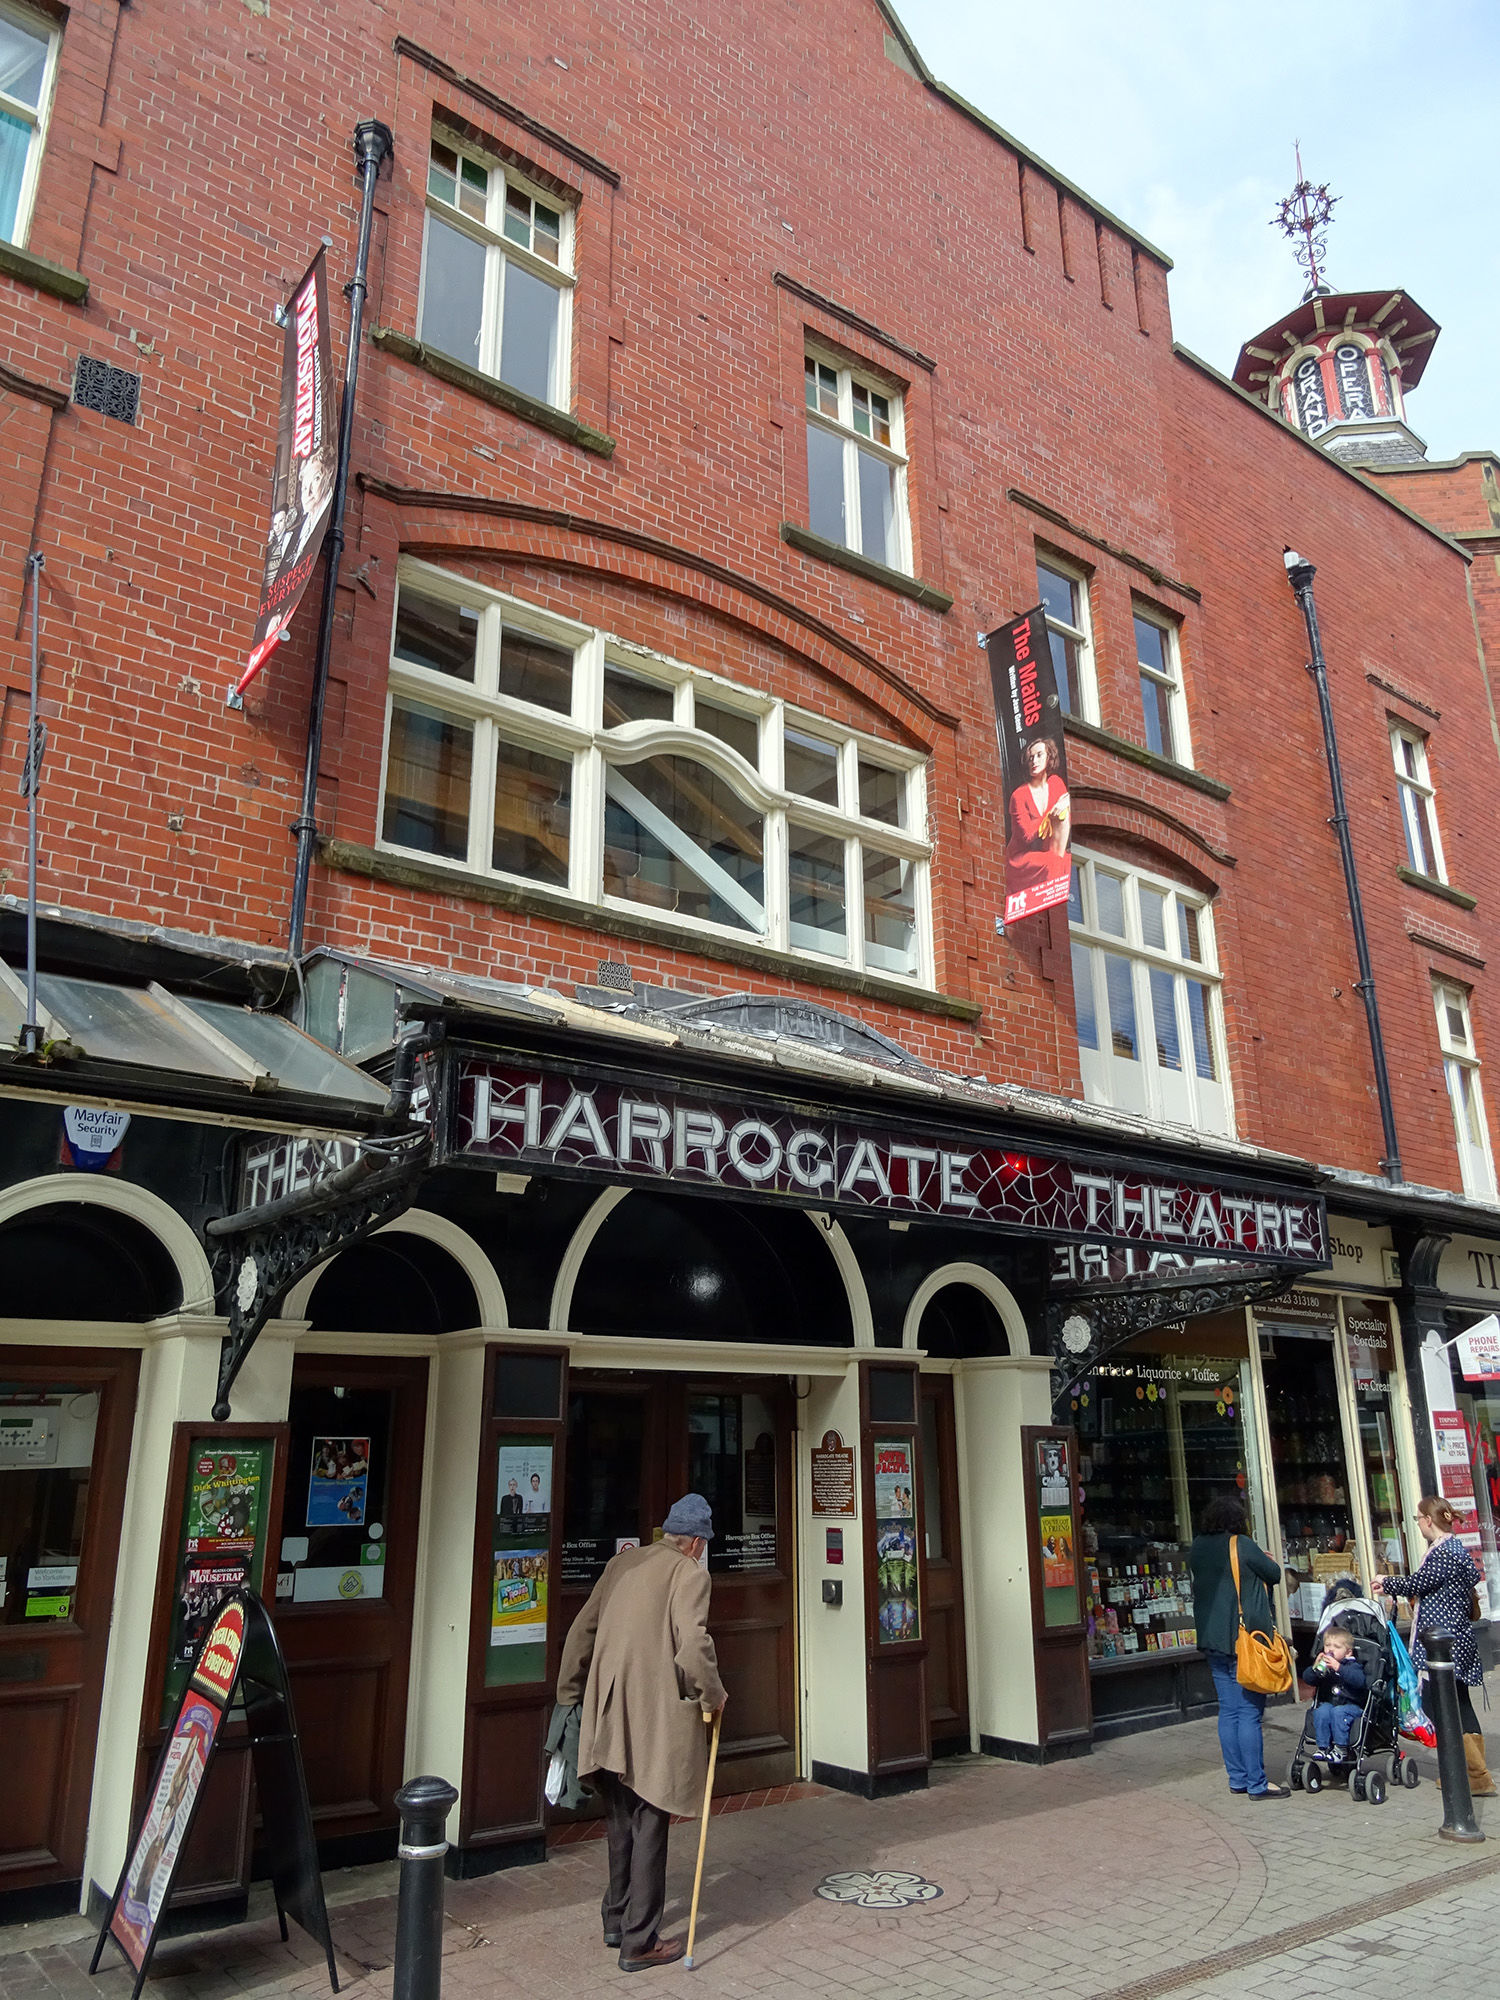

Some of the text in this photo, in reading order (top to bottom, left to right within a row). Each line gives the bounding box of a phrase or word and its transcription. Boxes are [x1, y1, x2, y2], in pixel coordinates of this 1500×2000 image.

[294, 273, 317, 457] MOUSETRAP
[1337, 347, 1369, 420] OPERA
[1298, 360, 1327, 441] GRAND
[267, 552, 313, 600] SUSPECT
[1012, 617, 1042, 727] The Maids
[74, 1108, 124, 1126] Mayfair
[77, 1122, 118, 1138] Security
[473, 1075, 1314, 1252] HARROGATE THEATRE
[1329, 1236, 1364, 1264] Shop
[1467, 1250, 1500, 1291] TI
[1293, 1294, 1320, 1307] 313180
[1348, 1316, 1388, 1335] Speciality
[1353, 1334, 1388, 1349] Cordials
[1468, 1336, 1498, 1345] PHONE
[1470, 1345, 1500, 1353] REPAIRS
[1136, 1365, 1182, 1383] Liquorice
[1191, 1367, 1220, 1382] Toffee
[1358, 1380, 1369, 1391] Ice
[875, 1462, 909, 1474] PACIFIC
[193, 1475, 260, 1493] Dick Whittington
[1050, 1524, 1070, 1533] FRIEND
[190, 1570, 245, 1583] MOUSETRAP
